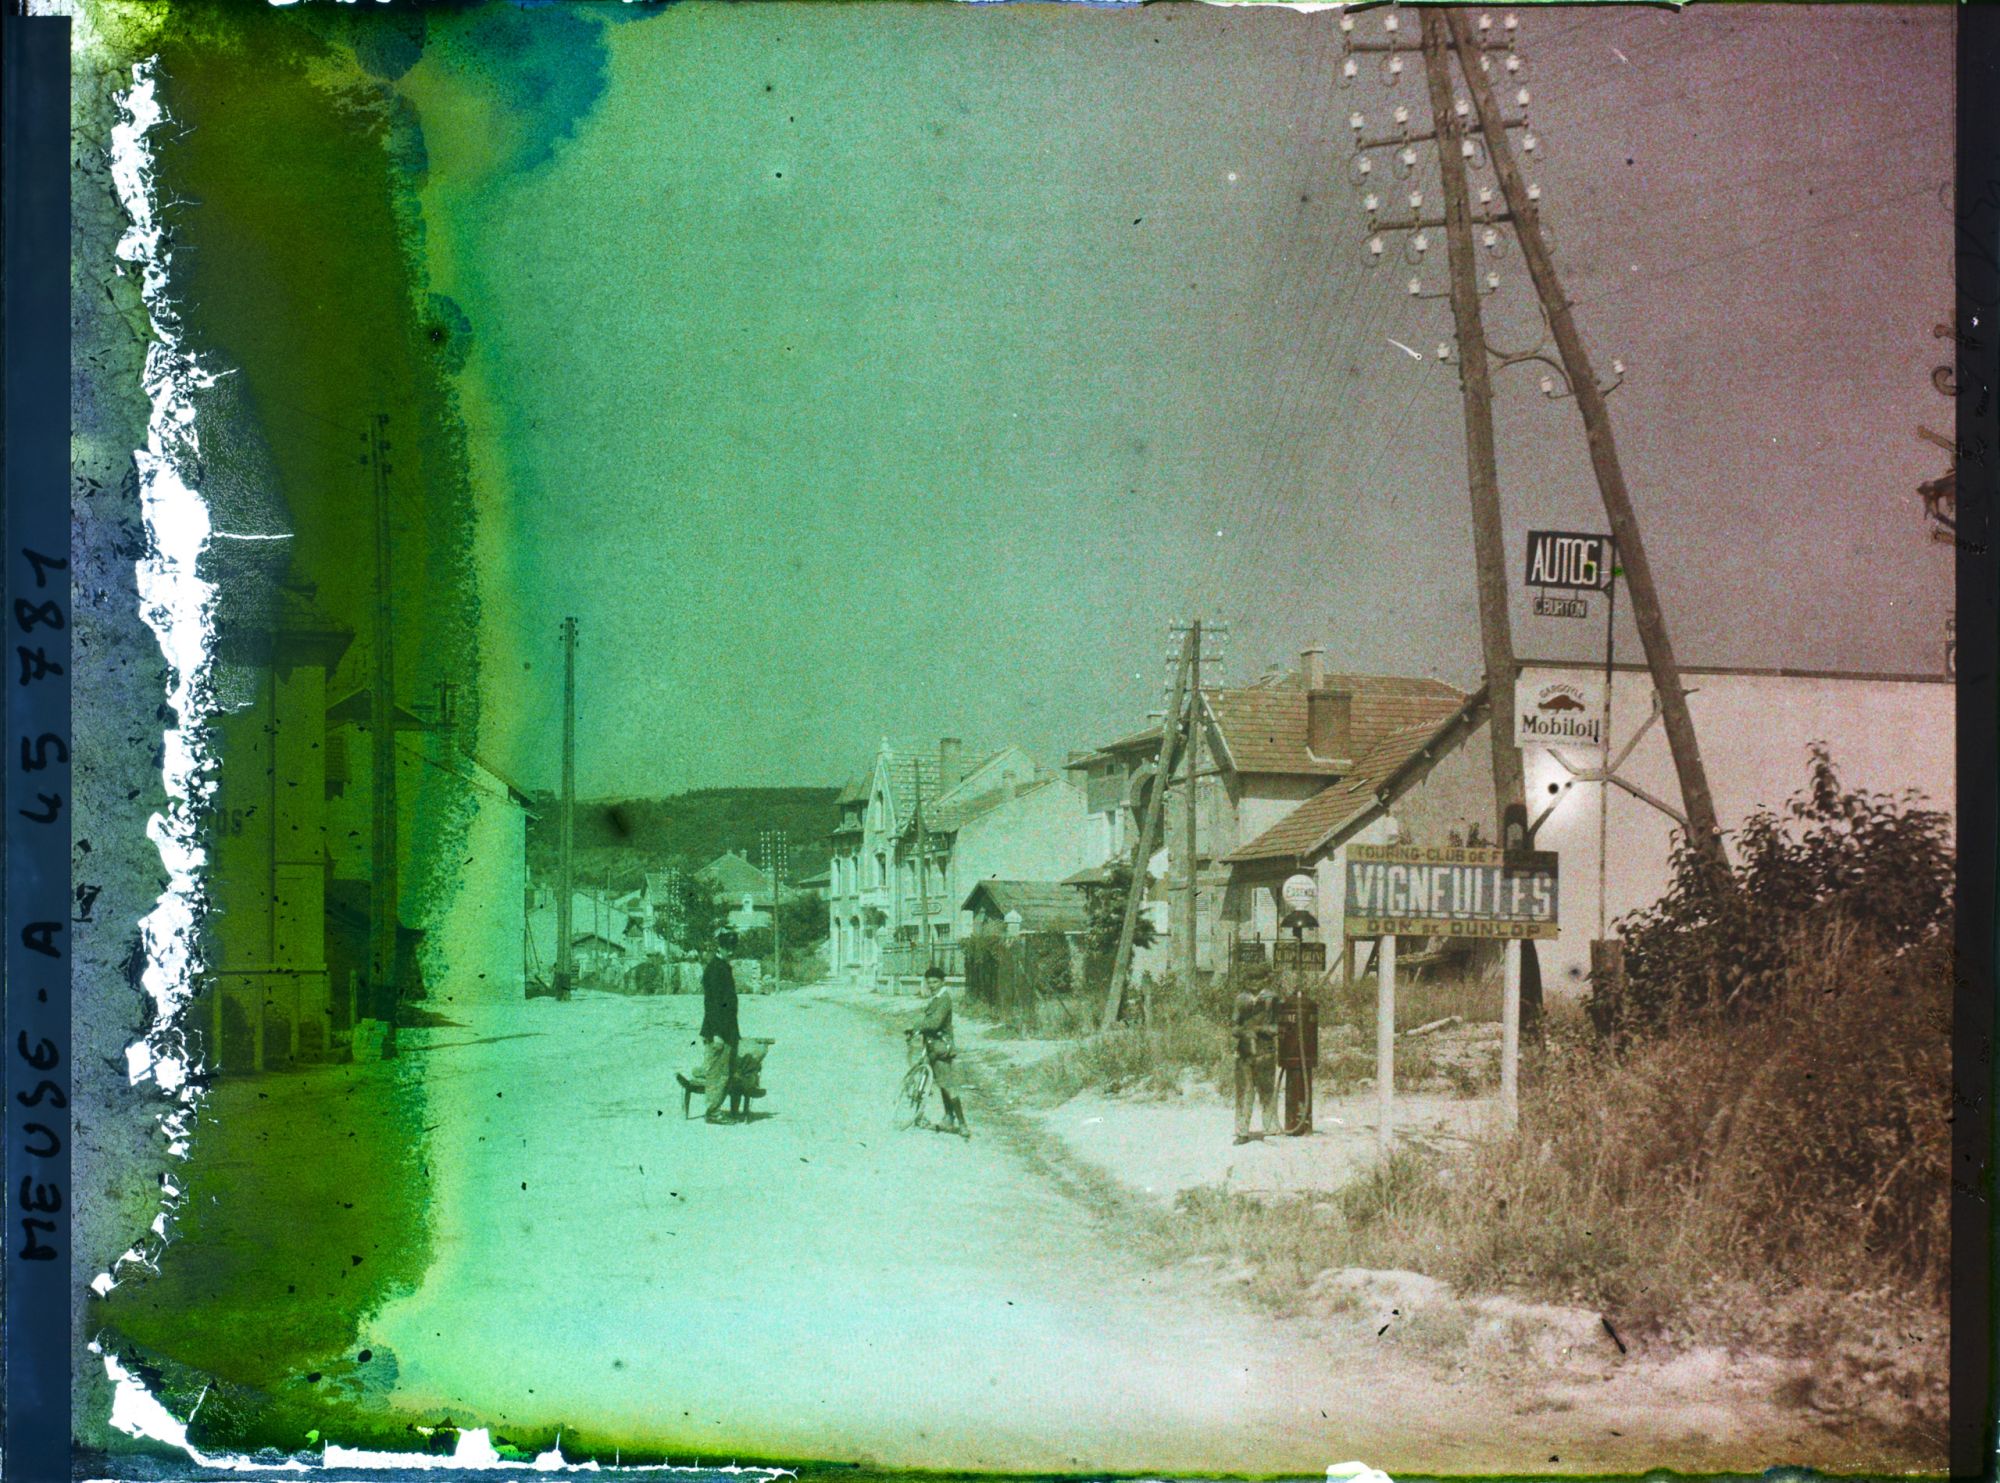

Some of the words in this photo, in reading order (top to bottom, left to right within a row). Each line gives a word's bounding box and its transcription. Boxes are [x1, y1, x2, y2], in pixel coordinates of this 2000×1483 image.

[1531, 537, 1599, 585] AUTOS
[1522, 714, 1600, 737] Mobiloil
[1357, 845, 1464, 862] TOURING-CLUB
[1469, 850, 1489, 862] DE
[1353, 863, 1552, 922] VIGNEULLES
[21, 921, 64, 957] A
[1367, 919, 1411, 933] DON
[1450, 921, 1541, 937] DUNLOP
[18, 1030, 65, 1260] MEUSE
